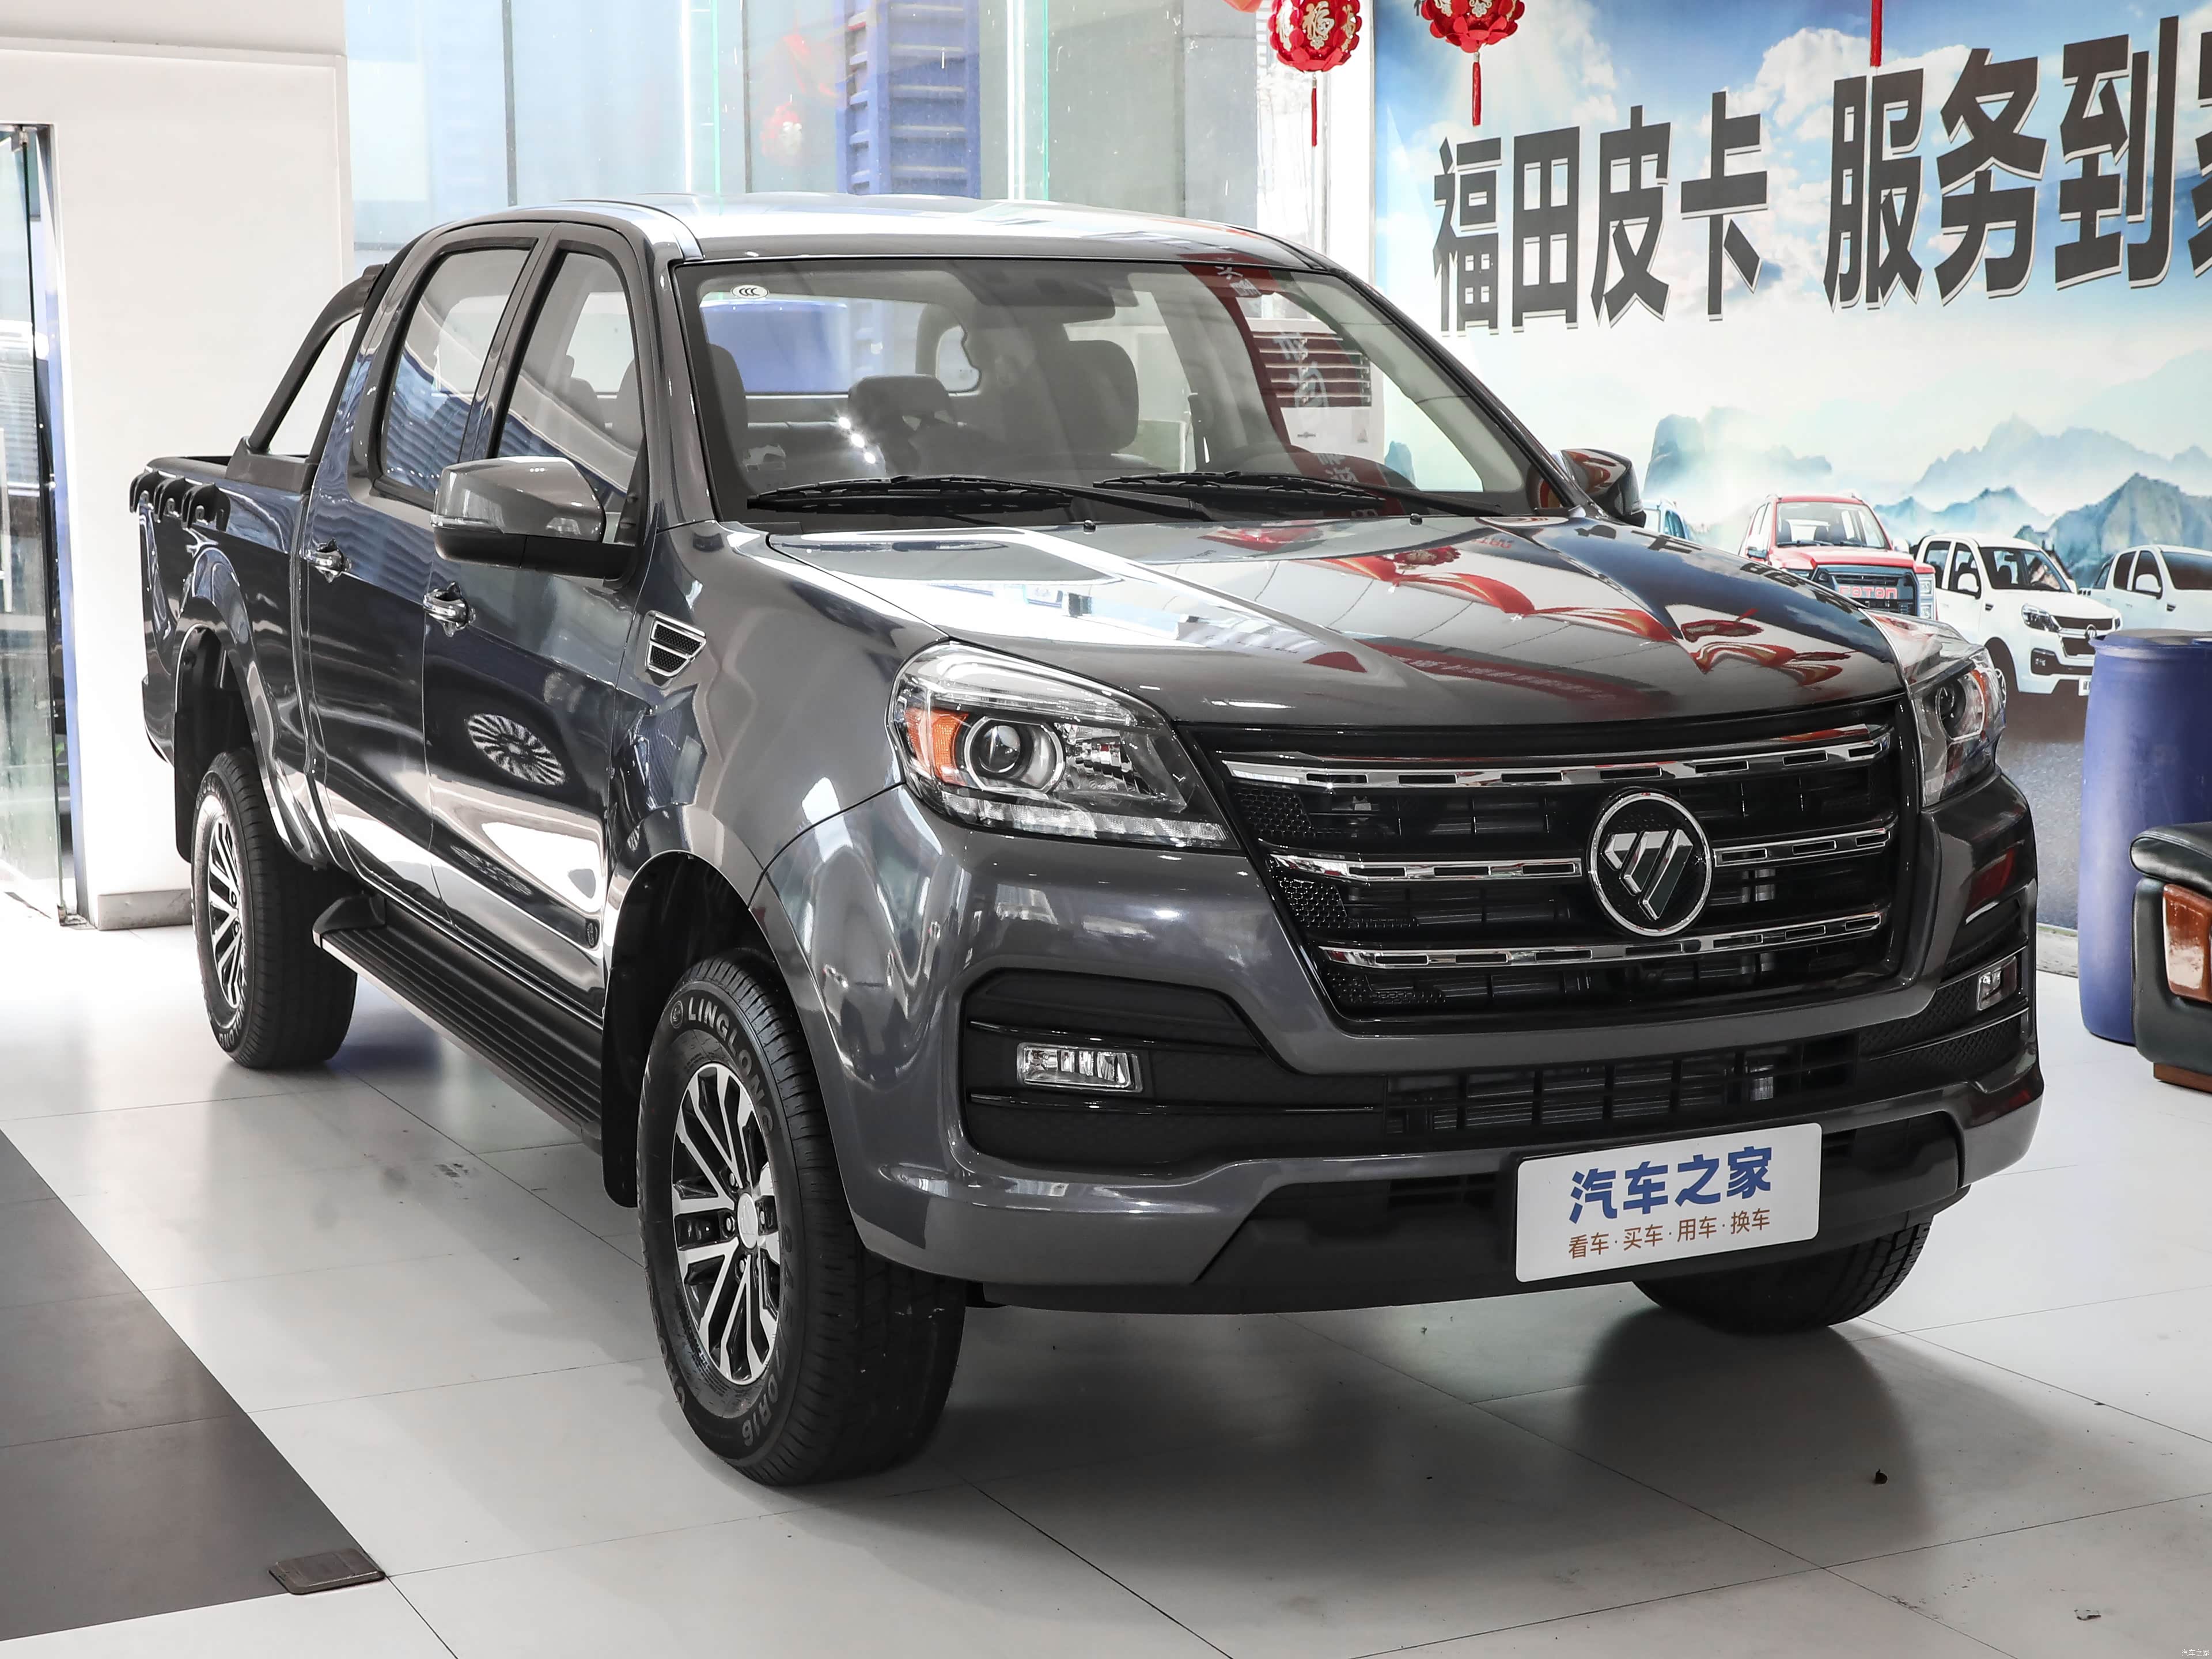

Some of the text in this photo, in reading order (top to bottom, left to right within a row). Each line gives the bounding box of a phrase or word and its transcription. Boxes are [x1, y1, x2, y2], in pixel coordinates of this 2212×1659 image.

[1433, 15, 2212, 337] 福田皮卡 服务到
[688, 997, 774, 1135] LINGLONG
[1569, 1146, 1772, 1224] 汽车之家
